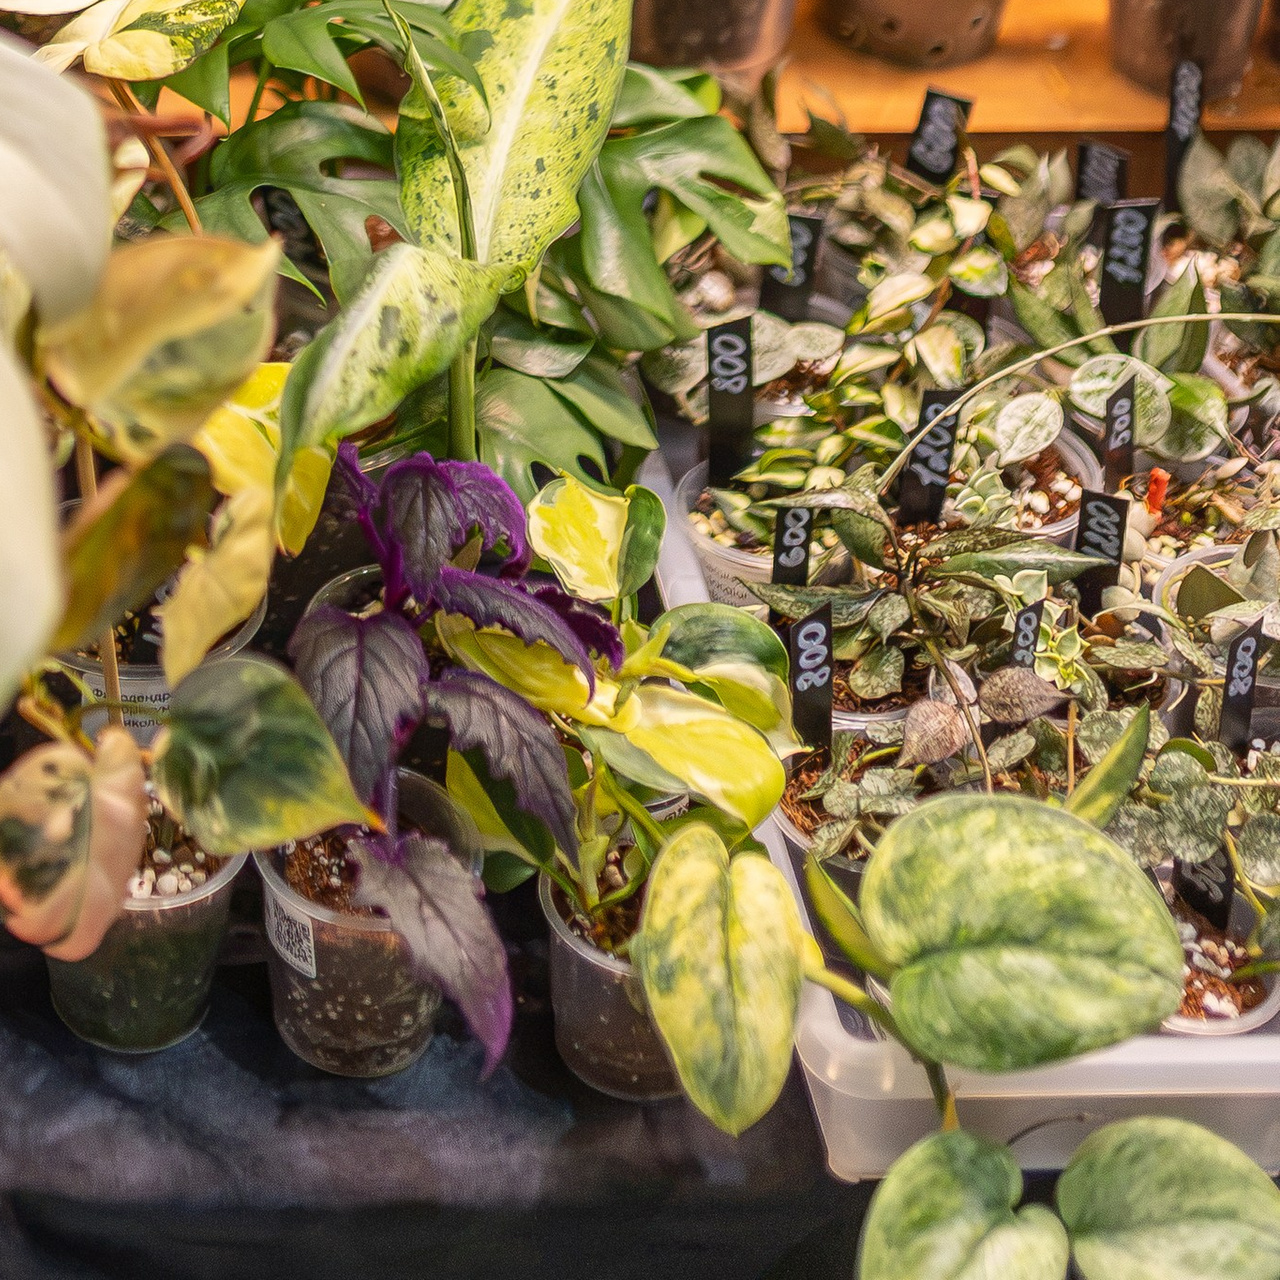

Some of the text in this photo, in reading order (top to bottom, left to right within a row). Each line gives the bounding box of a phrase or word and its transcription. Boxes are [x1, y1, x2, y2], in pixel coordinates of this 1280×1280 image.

[1106, 208, 1149, 283] 1200
[710, 332, 748, 393] 800
[910, 402, 957, 487] 1200
[1108, 396, 1132, 451] 500
[779, 507, 809, 568] 600
[795, 621, 831, 692] 800
[1013, 610, 1038, 667] 200
[1227, 636, 1255, 697] 800
